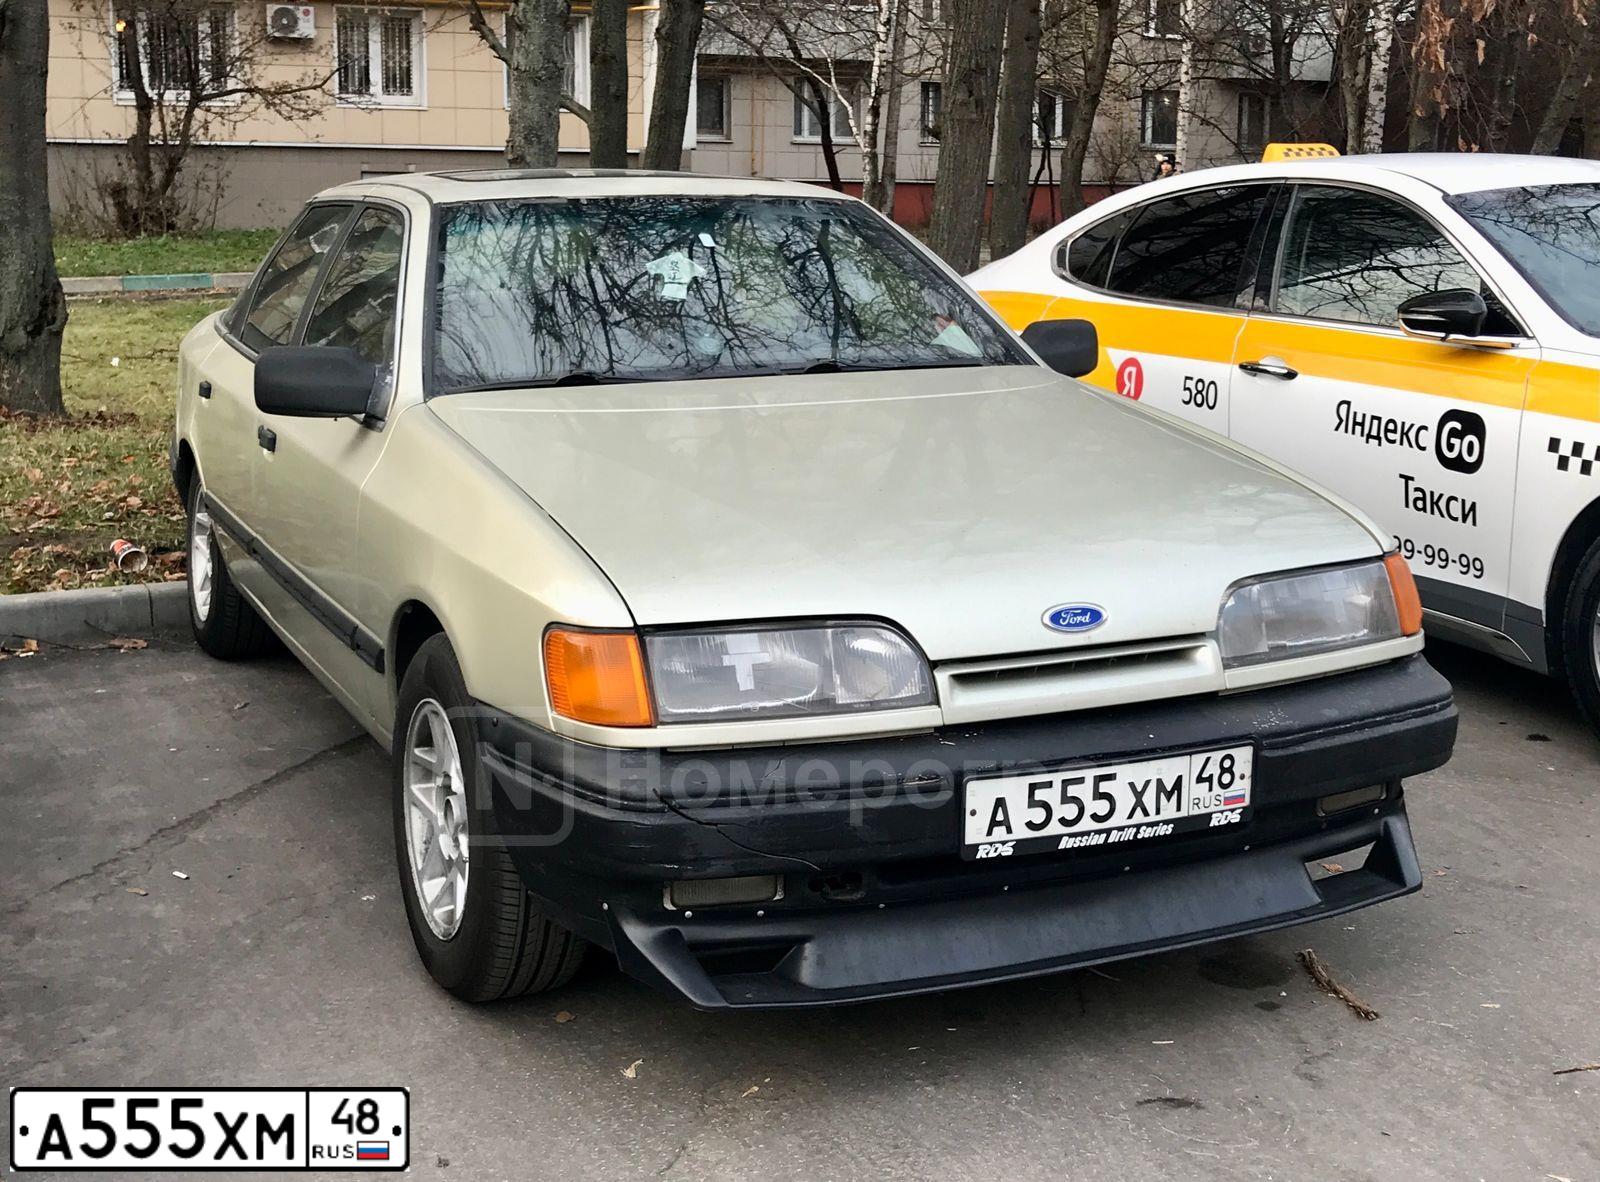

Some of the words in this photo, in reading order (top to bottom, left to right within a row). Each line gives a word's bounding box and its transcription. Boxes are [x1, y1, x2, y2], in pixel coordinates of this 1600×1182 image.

[1122, 366, 1137, 397] Я
[1182, 376, 1218, 410] 580
[1334, 400, 1429, 451] Яндекс
[1440, 420, 1481, 463] Go
[1399, 473, 1478, 526] Такси
[1060, 610, 1092, 625] Ford
[1195, 754, 1236, 793] 48
[1192, 794, 1222, 811] RUS
[1209, 809, 1243, 827] RDS
[976, 841, 1017, 859] RDS
[1058, 832, 1107, 849] Russian
[1107, 827, 1137, 843] Drift
[1137, 823, 1174, 839] Series
